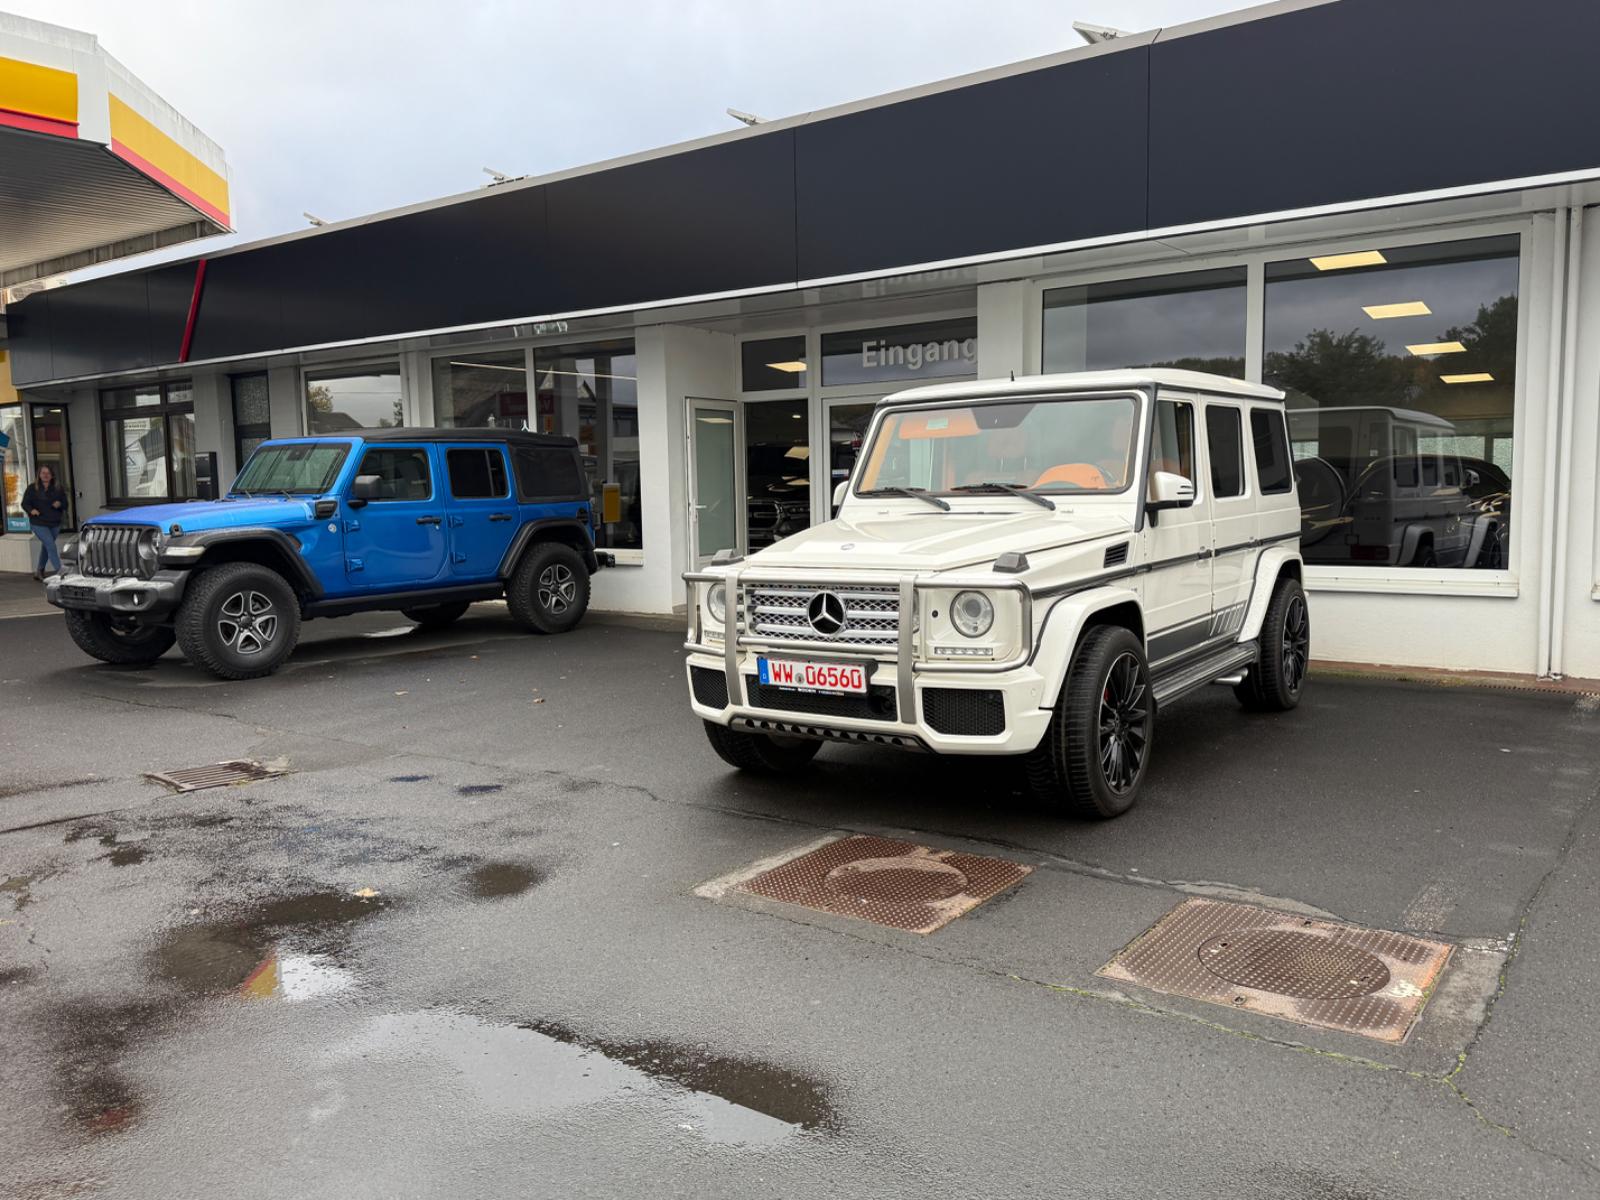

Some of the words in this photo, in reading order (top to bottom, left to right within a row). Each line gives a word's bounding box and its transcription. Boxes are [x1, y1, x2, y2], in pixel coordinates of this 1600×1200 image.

[862, 338, 977, 370] Eingang
[771, 662, 793, 683] WW
[805, 665, 863, 689] 06560
